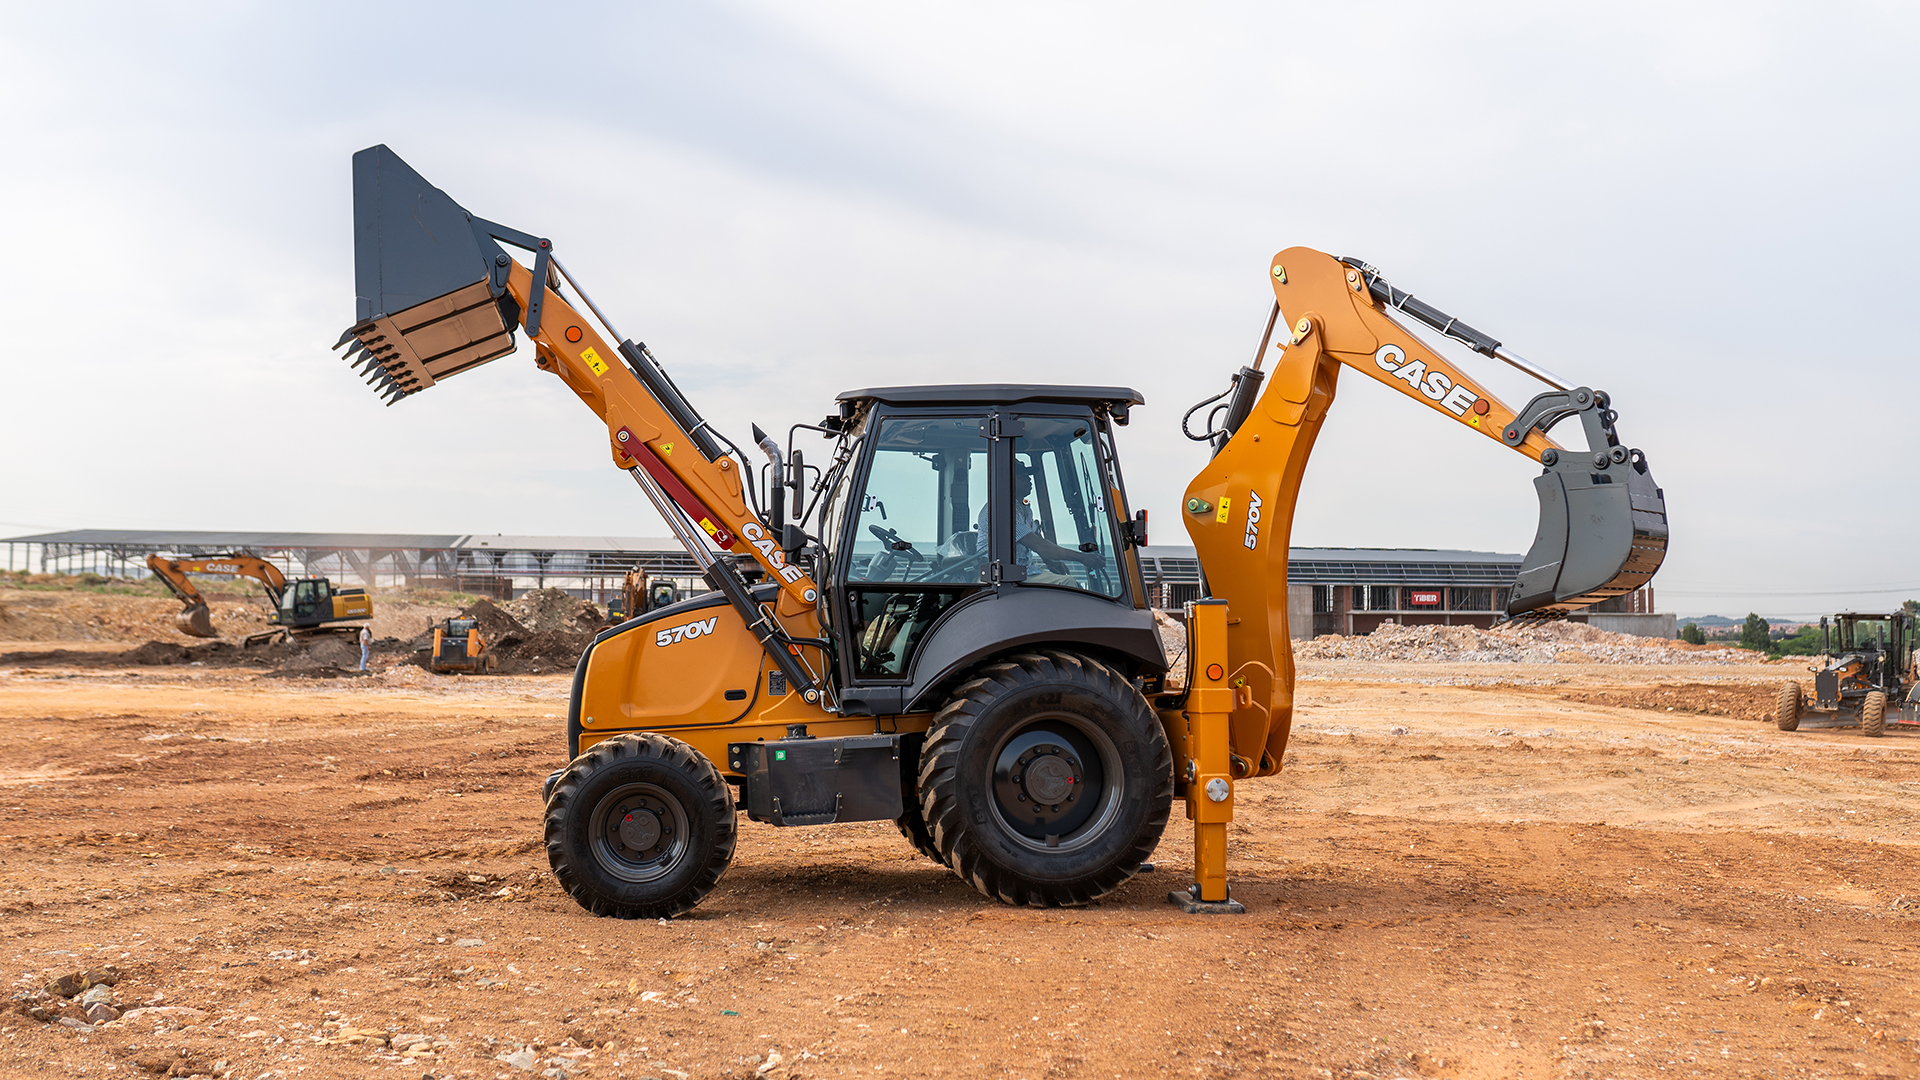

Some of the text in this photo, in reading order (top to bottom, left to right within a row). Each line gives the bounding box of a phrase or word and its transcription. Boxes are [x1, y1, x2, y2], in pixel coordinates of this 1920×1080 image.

[1374, 343, 1480, 418] CASE
[1243, 489, 1263, 551] 570V
[206, 562, 239, 574] CASE
[741, 522, 804, 584] CASE
[655, 615, 719, 647] 570V
